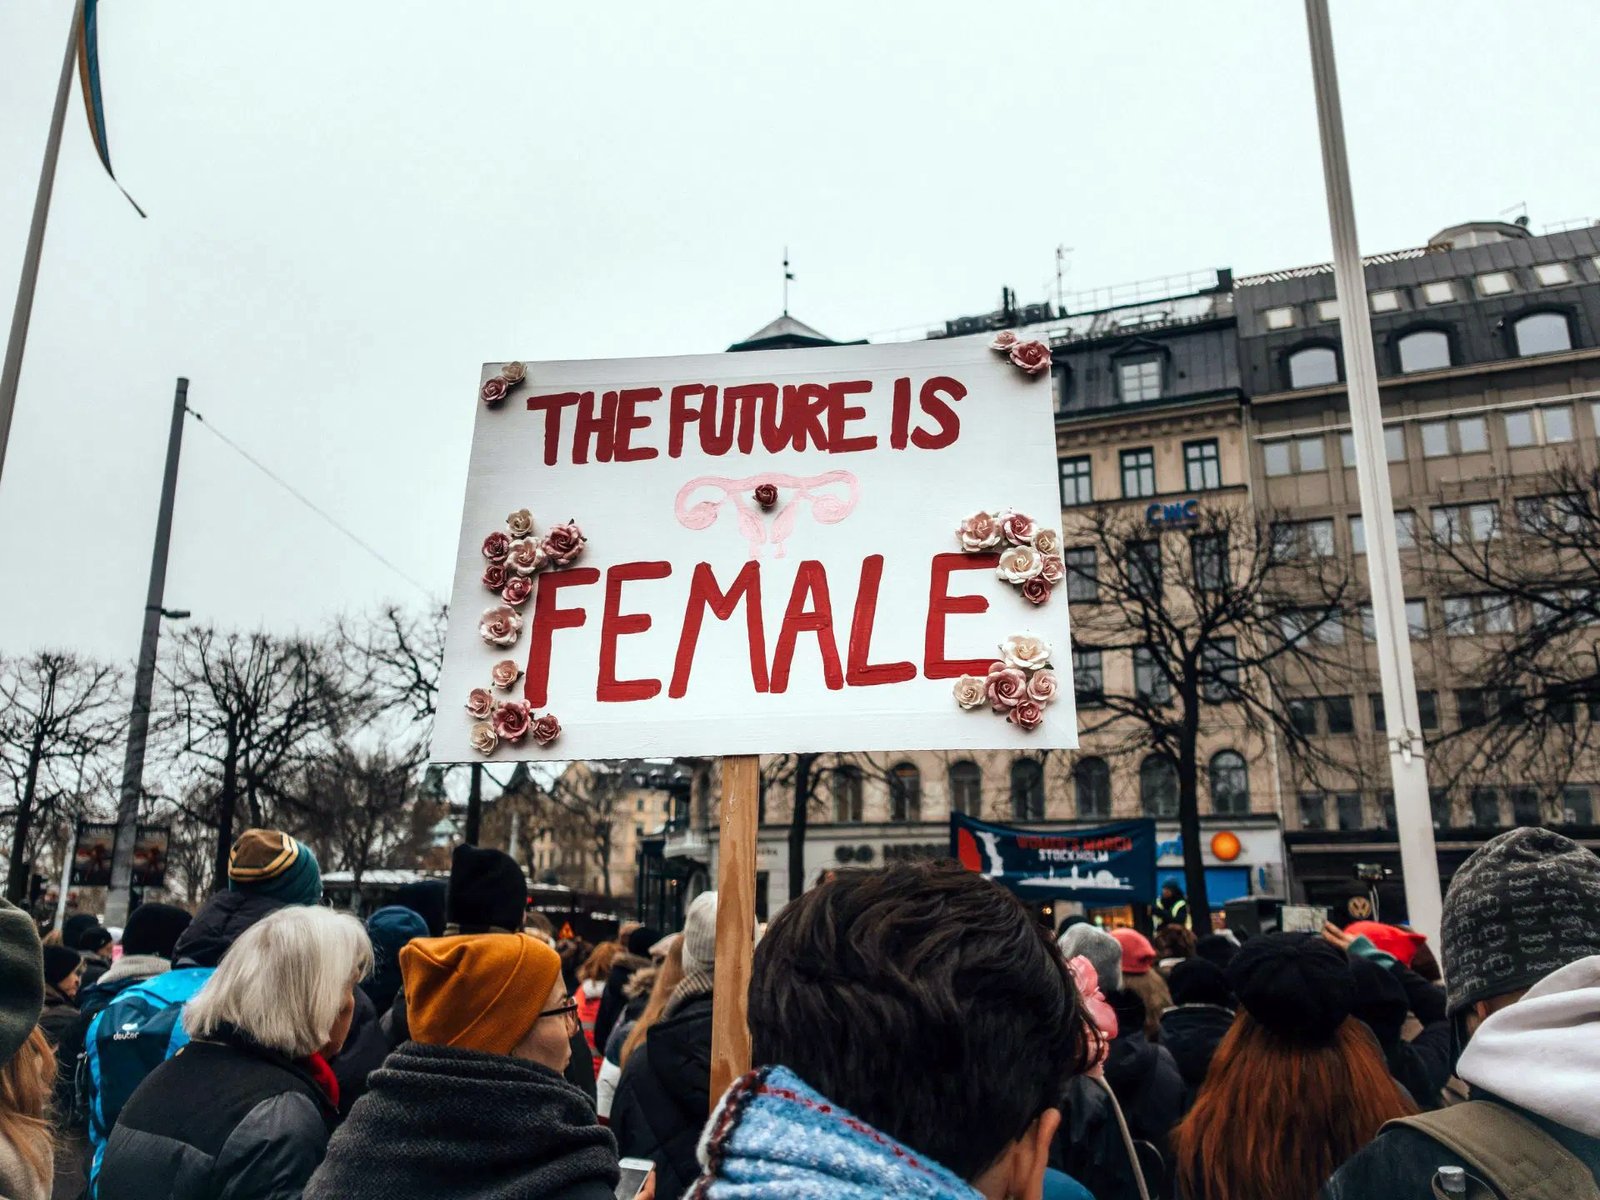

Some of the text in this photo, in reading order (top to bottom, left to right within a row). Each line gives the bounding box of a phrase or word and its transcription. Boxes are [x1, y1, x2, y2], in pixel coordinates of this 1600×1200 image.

[527, 376, 968, 466] THE FUTURE IS
[523, 553, 1005, 710] FEMALE
[1038, 848, 1109, 863] STOCKHOLM
[112, 1030, 140, 1041] deuter
